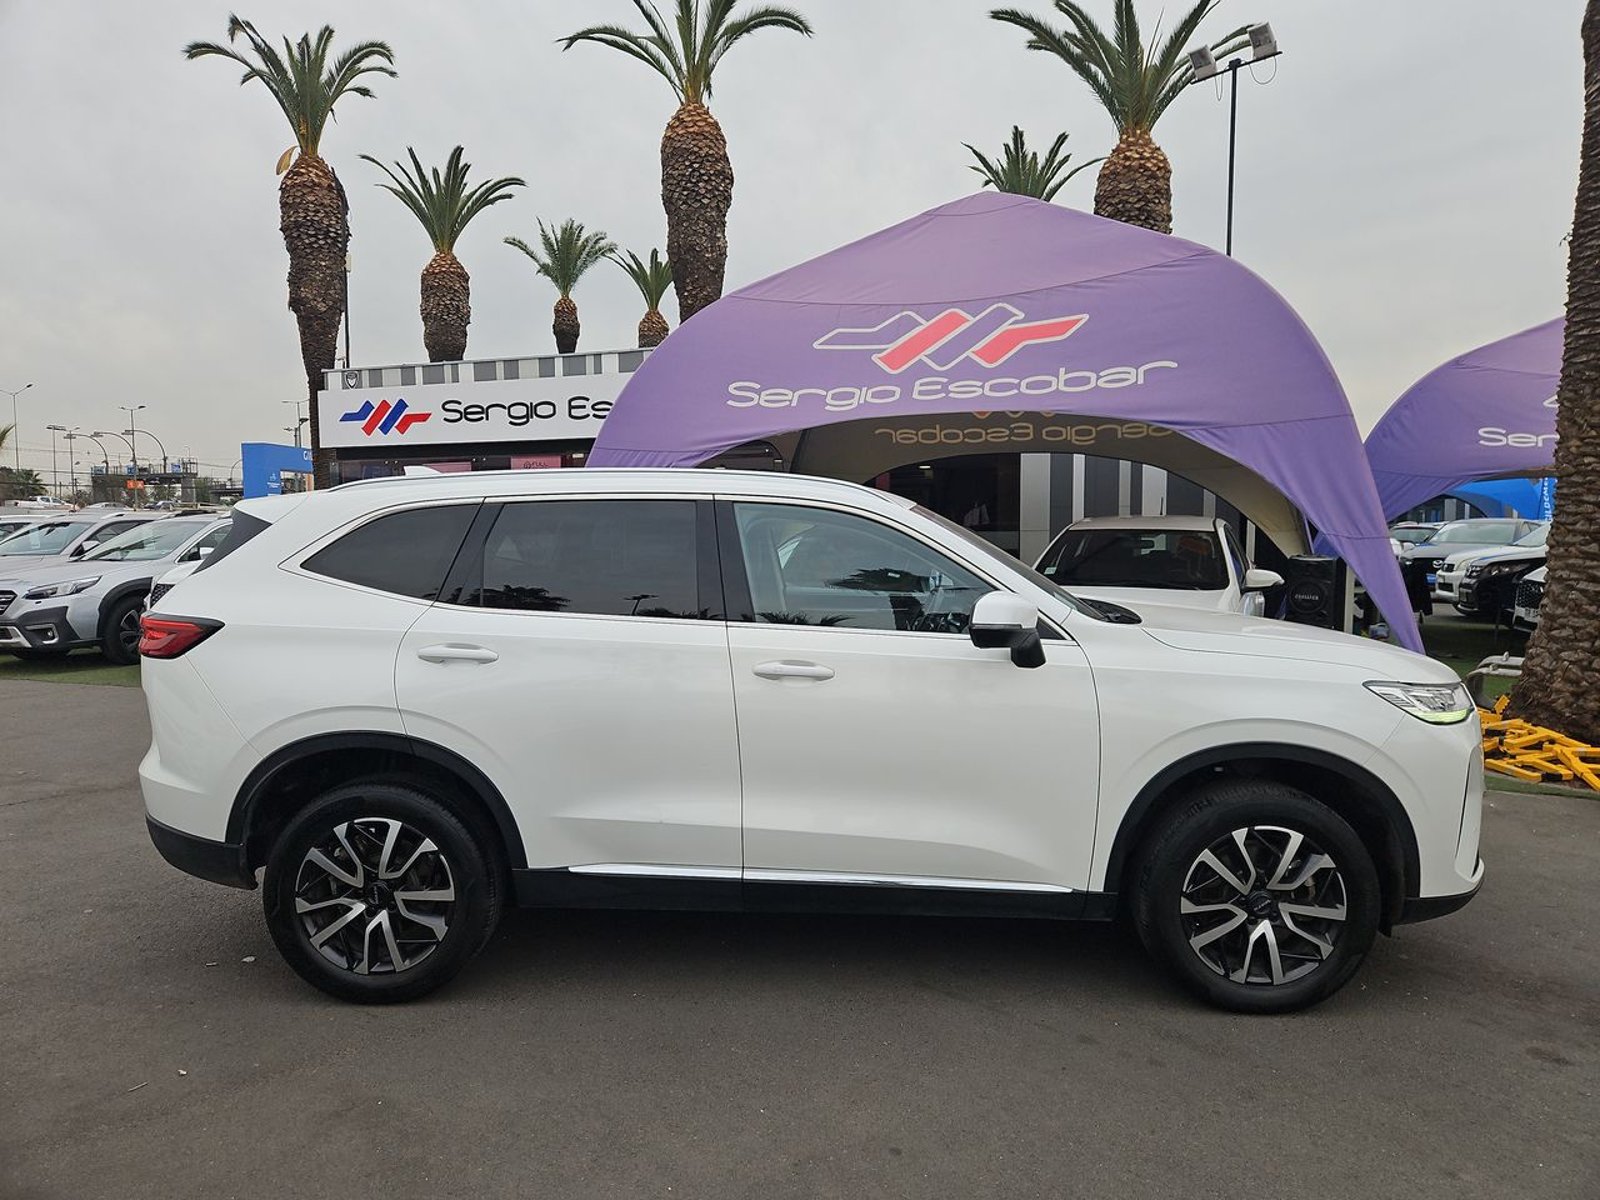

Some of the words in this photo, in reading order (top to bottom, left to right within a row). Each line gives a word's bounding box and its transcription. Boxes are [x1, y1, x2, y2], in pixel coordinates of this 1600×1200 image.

[726, 380, 901, 411] Sergio
[912, 360, 1178, 401] Escobar
[441, 399, 557, 427] Sergio
